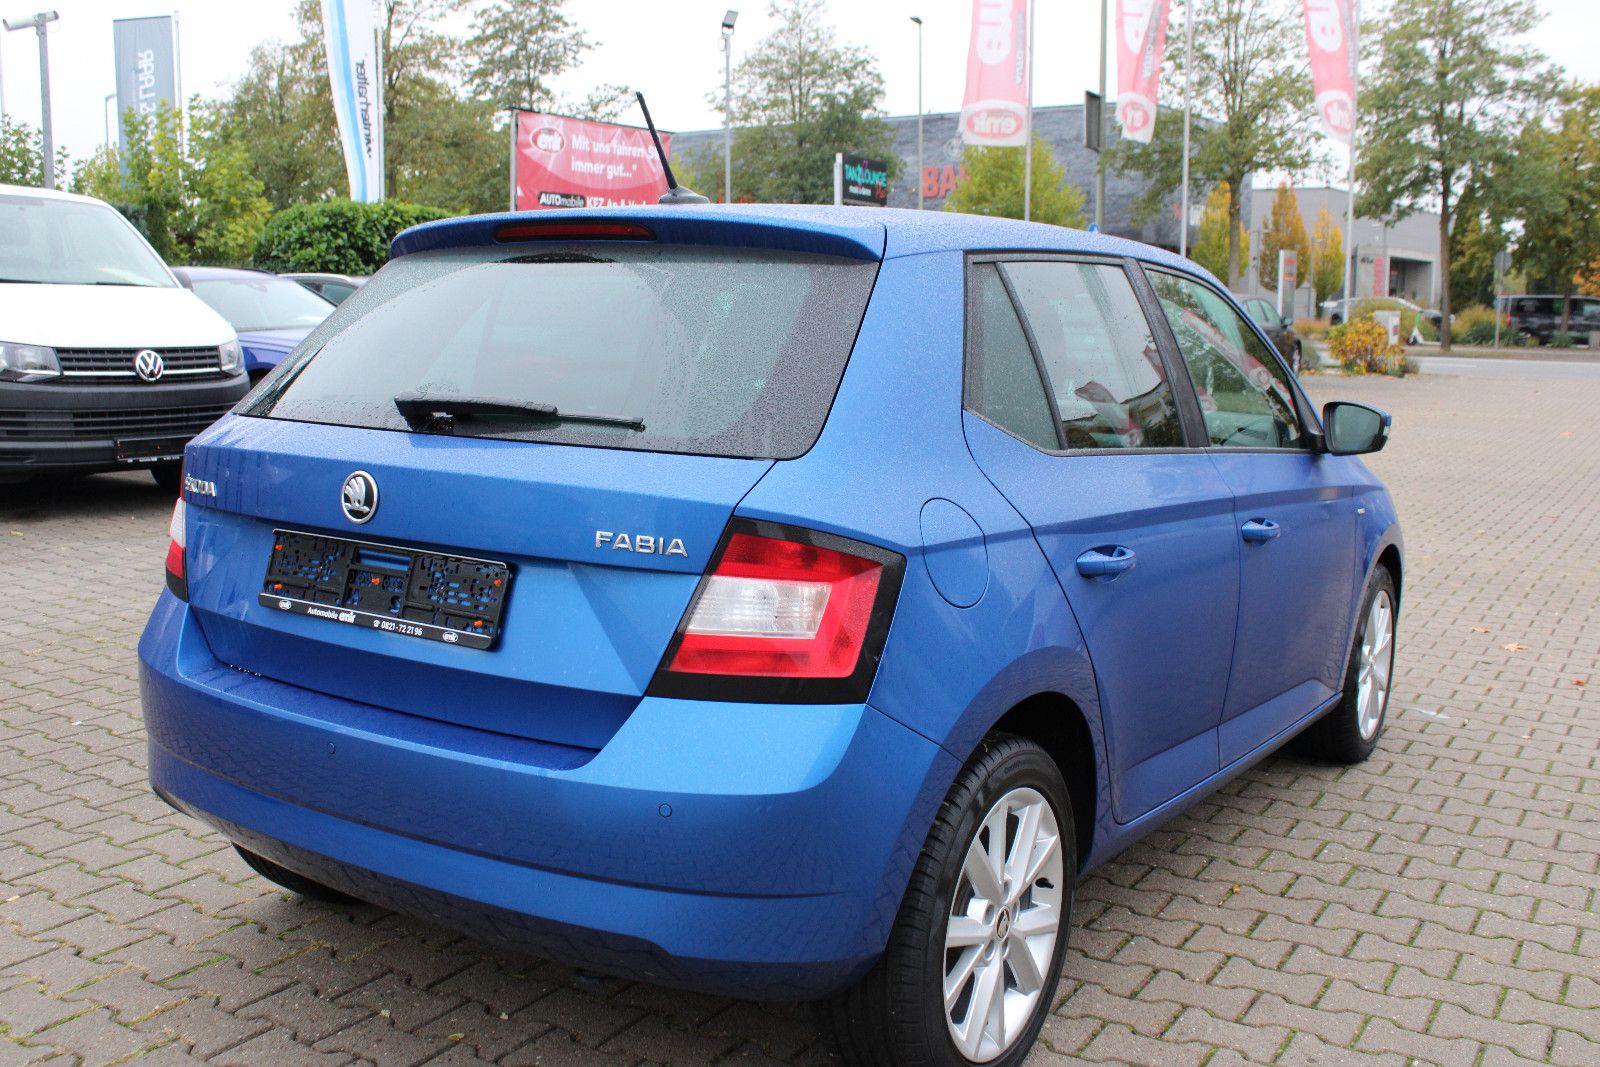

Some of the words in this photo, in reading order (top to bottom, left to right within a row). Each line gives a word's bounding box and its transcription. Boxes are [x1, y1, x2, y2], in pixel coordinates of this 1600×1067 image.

[572, 134, 590, 151] Mit
[595, 530, 688, 557] FABIA
[307, 606, 338, 620] Automobile
[338, 610, 357, 624] emir
